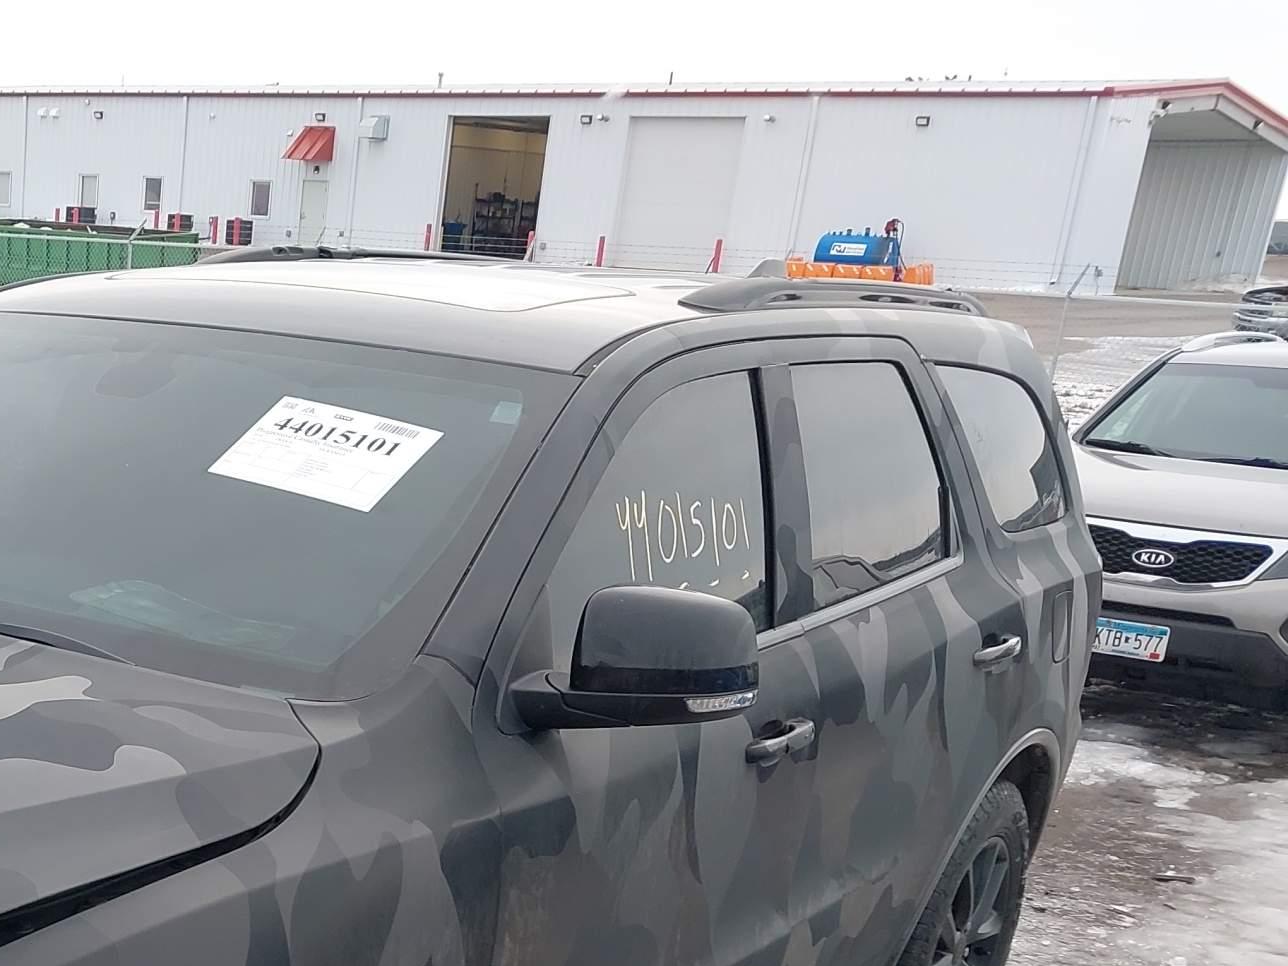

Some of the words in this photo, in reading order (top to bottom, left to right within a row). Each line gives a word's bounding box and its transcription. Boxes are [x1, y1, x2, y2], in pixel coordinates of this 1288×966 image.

[274, 416, 401, 456] 44015101
[615, 489, 750, 583] 44015101
[1140, 552, 1165, 564] KIA
[1133, 633, 1164, 652] 577
